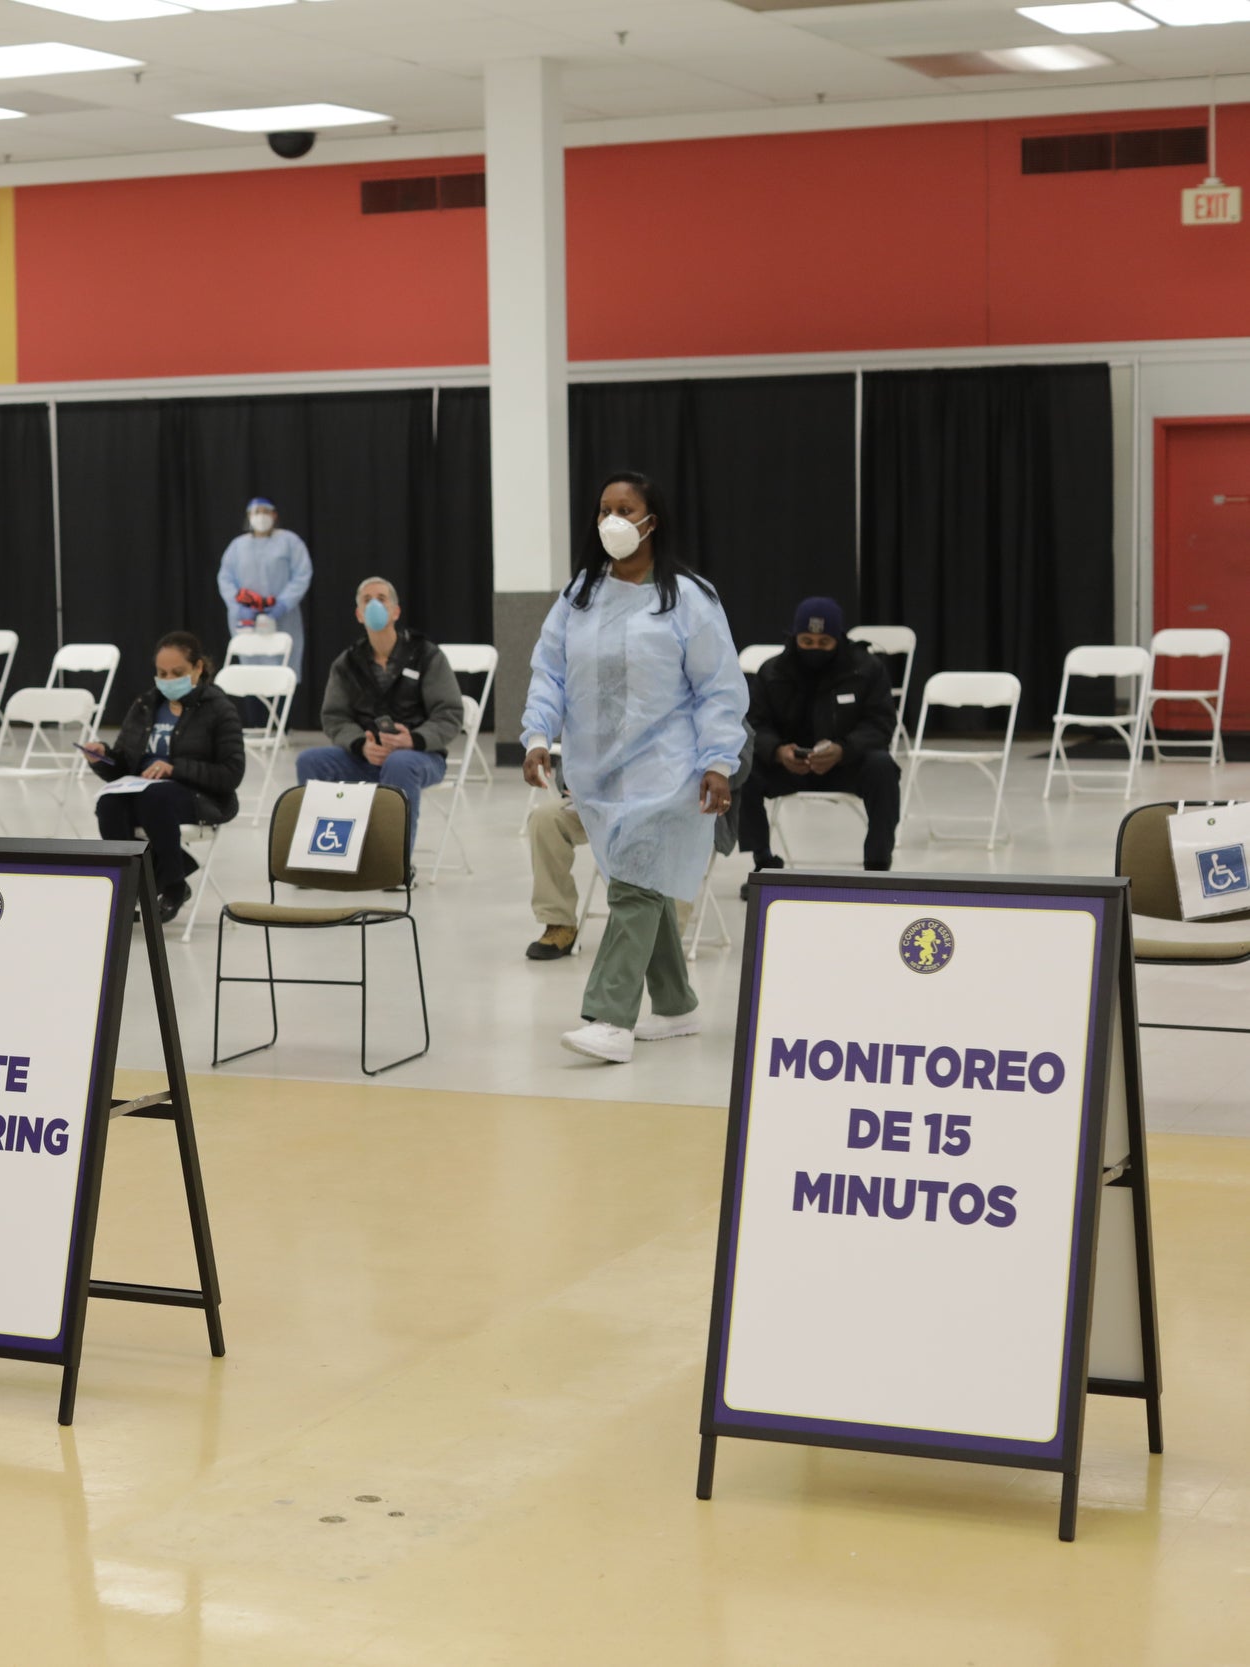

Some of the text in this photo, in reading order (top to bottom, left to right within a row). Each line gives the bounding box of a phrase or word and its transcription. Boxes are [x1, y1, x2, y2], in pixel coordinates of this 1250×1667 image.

[1195, 193, 1230, 219] EXIT
[903, 921, 952, 947] COUNTY OF ESSEX
[768, 1037, 1066, 1095] MONITOREO
[846, 1107, 972, 1157] DE 15
[792, 1170, 1018, 1228] MINUTOS
